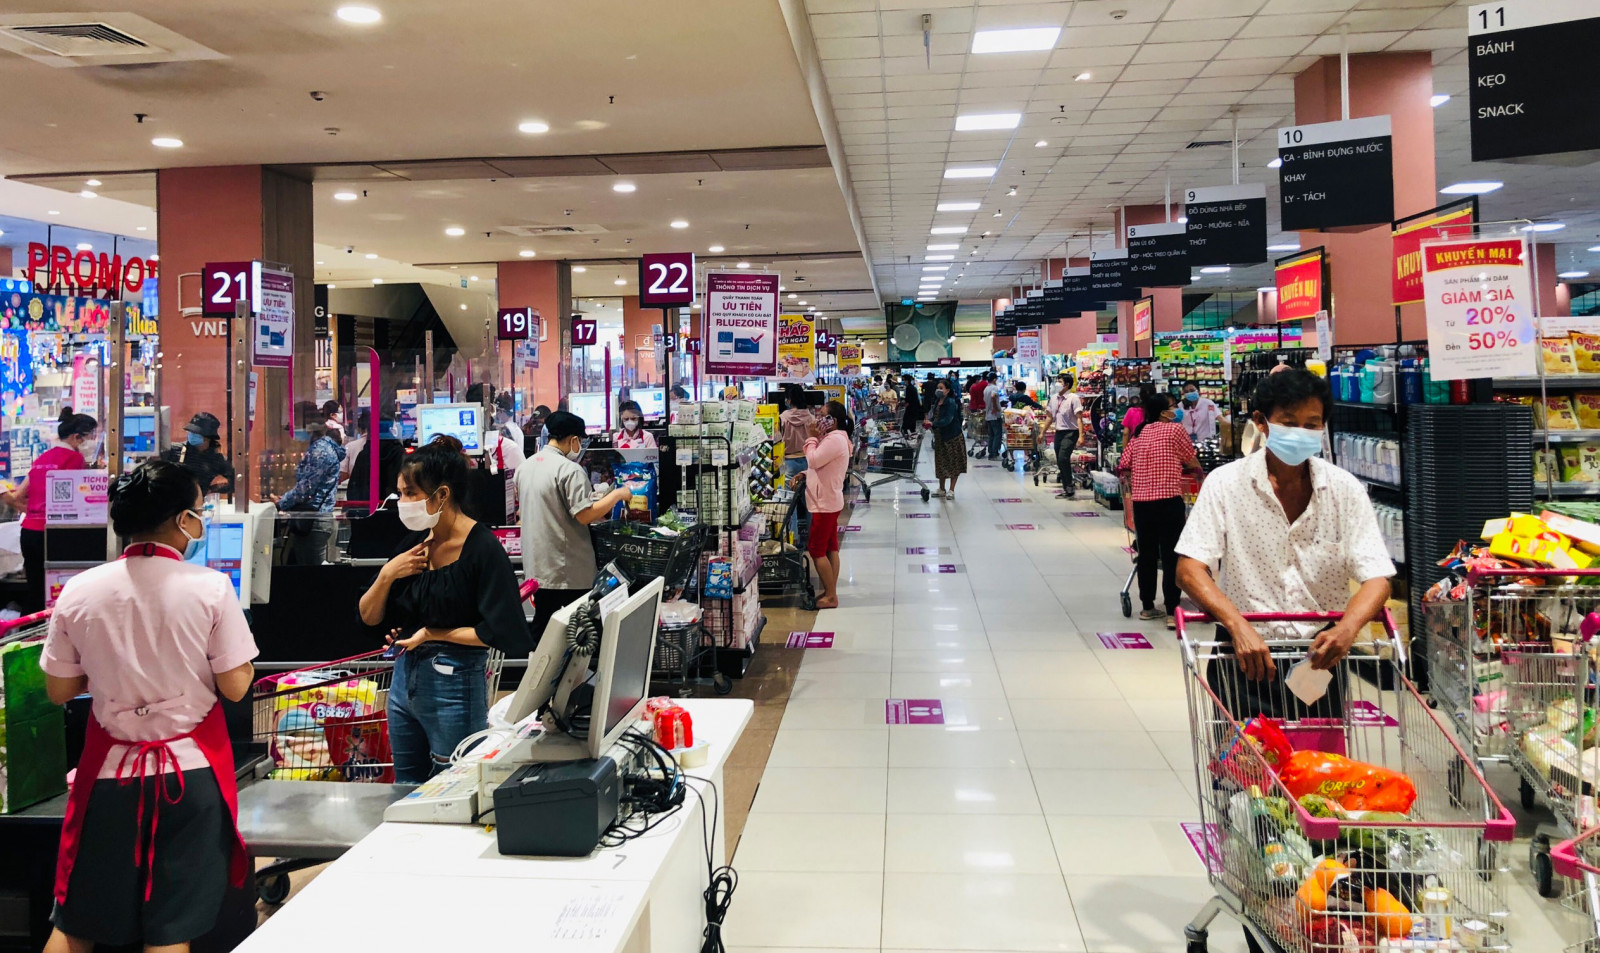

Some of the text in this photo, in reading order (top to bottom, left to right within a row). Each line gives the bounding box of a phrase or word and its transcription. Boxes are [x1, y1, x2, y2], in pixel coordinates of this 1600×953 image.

[1478, 6, 1505, 30] 11
[1476, 39, 1515, 57] BÁNH
[1477, 74, 1506, 88] KẸO
[1477, 103, 1524, 119] SNACK
[1284, 129, 1303, 145] 10
[1283, 153, 1295, 163] CA
[1303, 149, 1325, 161] BÌNH
[1327, 147, 1354, 159] ĐỰNG
[1356, 141, 1384, 154] NƯỚC
[1284, 173, 1306, 184] KHAY
[1188, 191, 1196, 202] 9
[1284, 193, 1295, 204] LY
[1303, 190, 1326, 202] TÁCH
[1188, 205, 1199, 214] ĐỒ
[1200, 205, 1218, 214] DÙNG
[1130, 228, 1136, 236] 8
[1435, 246, 1512, 264] KHUYẾN MẠI
[648, 263, 689, 294] 22
[211, 271, 247, 304] 21
[1441, 285, 1514, 305] GIẢM GIÁ
[722, 301, 762, 311] ƯU TIÊN
[503, 313, 525, 332] 19
[716, 318, 768, 328] BLUEZONE
[1466, 305, 1515, 326] 20%
[190, 322, 227, 336] VND
[575, 323, 595, 340] 17
[779, 321, 810, 337] HẤP
[828, 337, 835, 348] 2
[1468, 330, 1517, 350] 50%
